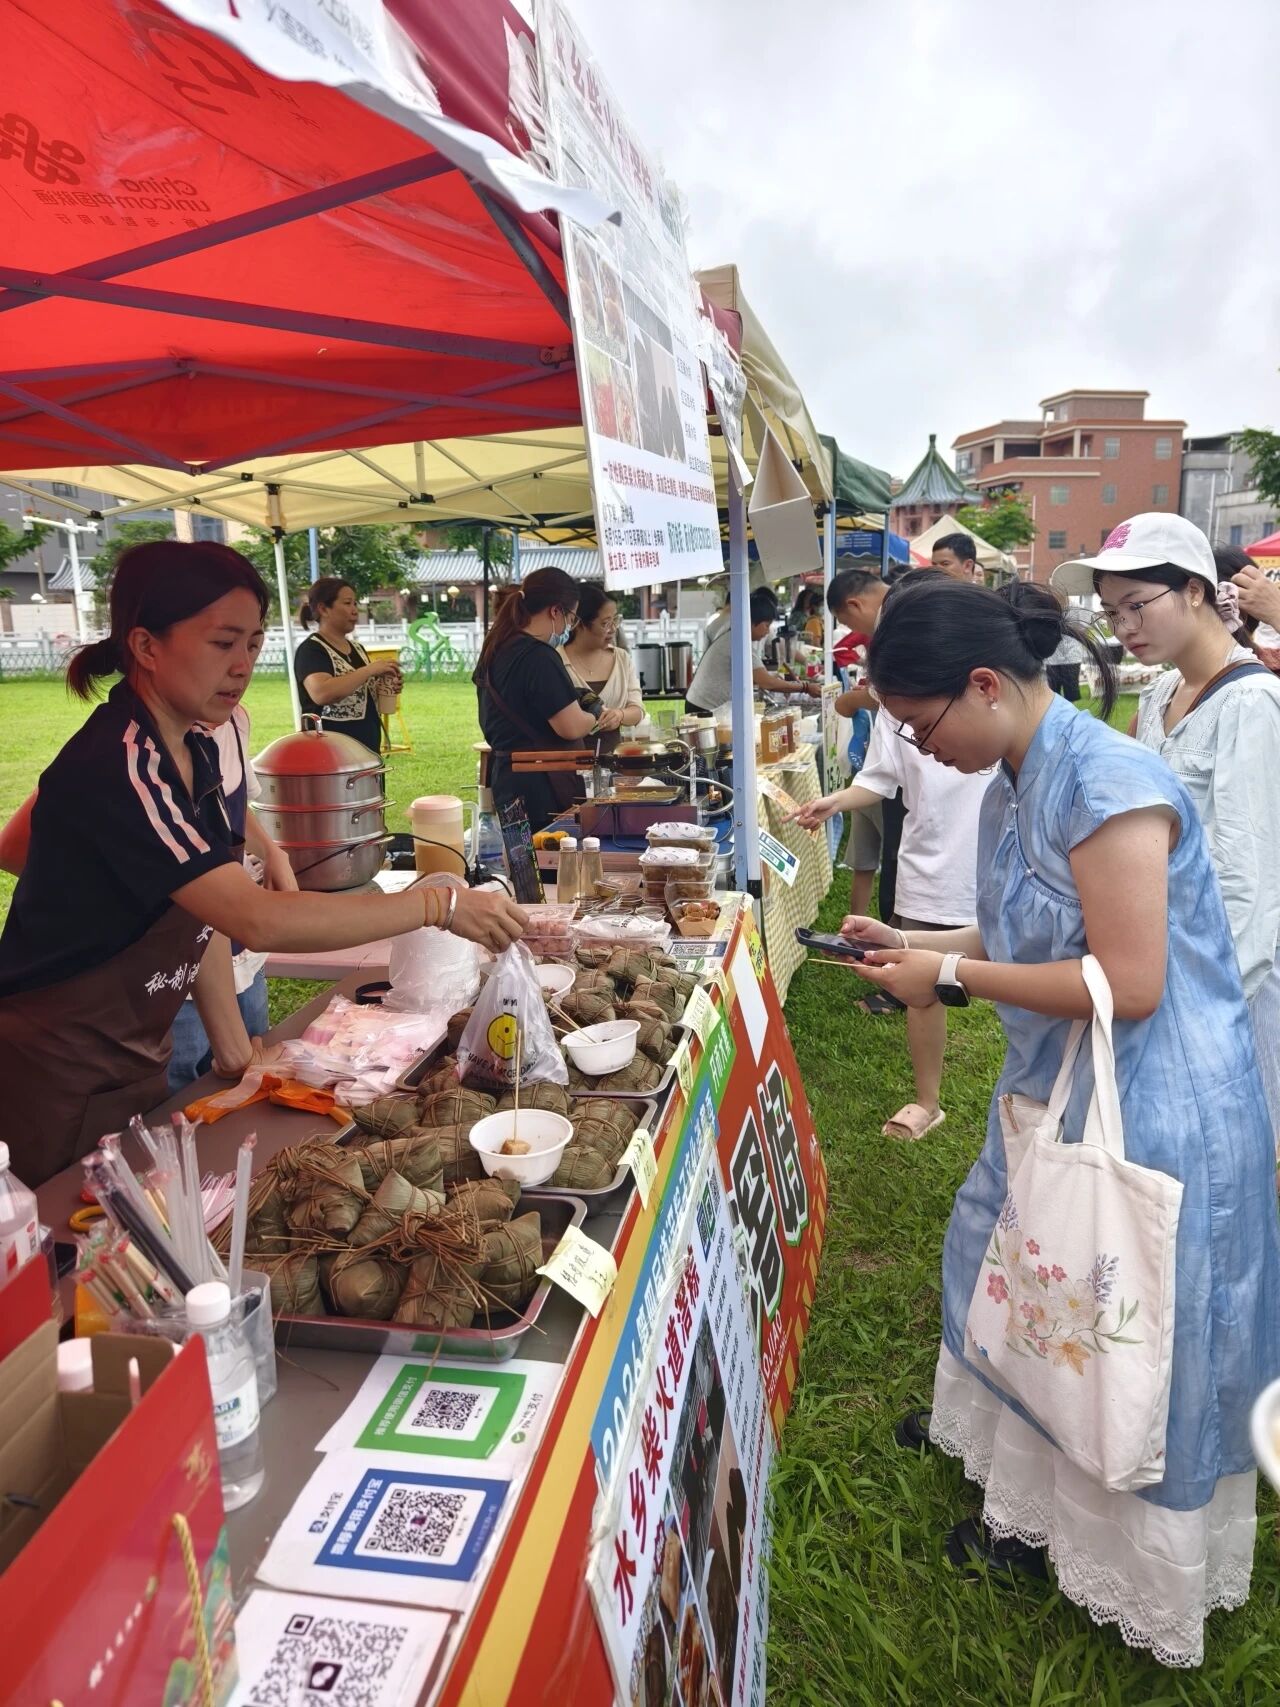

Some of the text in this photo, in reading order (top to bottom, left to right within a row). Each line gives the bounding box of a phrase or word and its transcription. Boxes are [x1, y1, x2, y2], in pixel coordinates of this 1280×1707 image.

[374, 1376, 418, 1437] 推荐使用微信支付
[330, 1479, 383, 1556] 推荐使用支付宝
